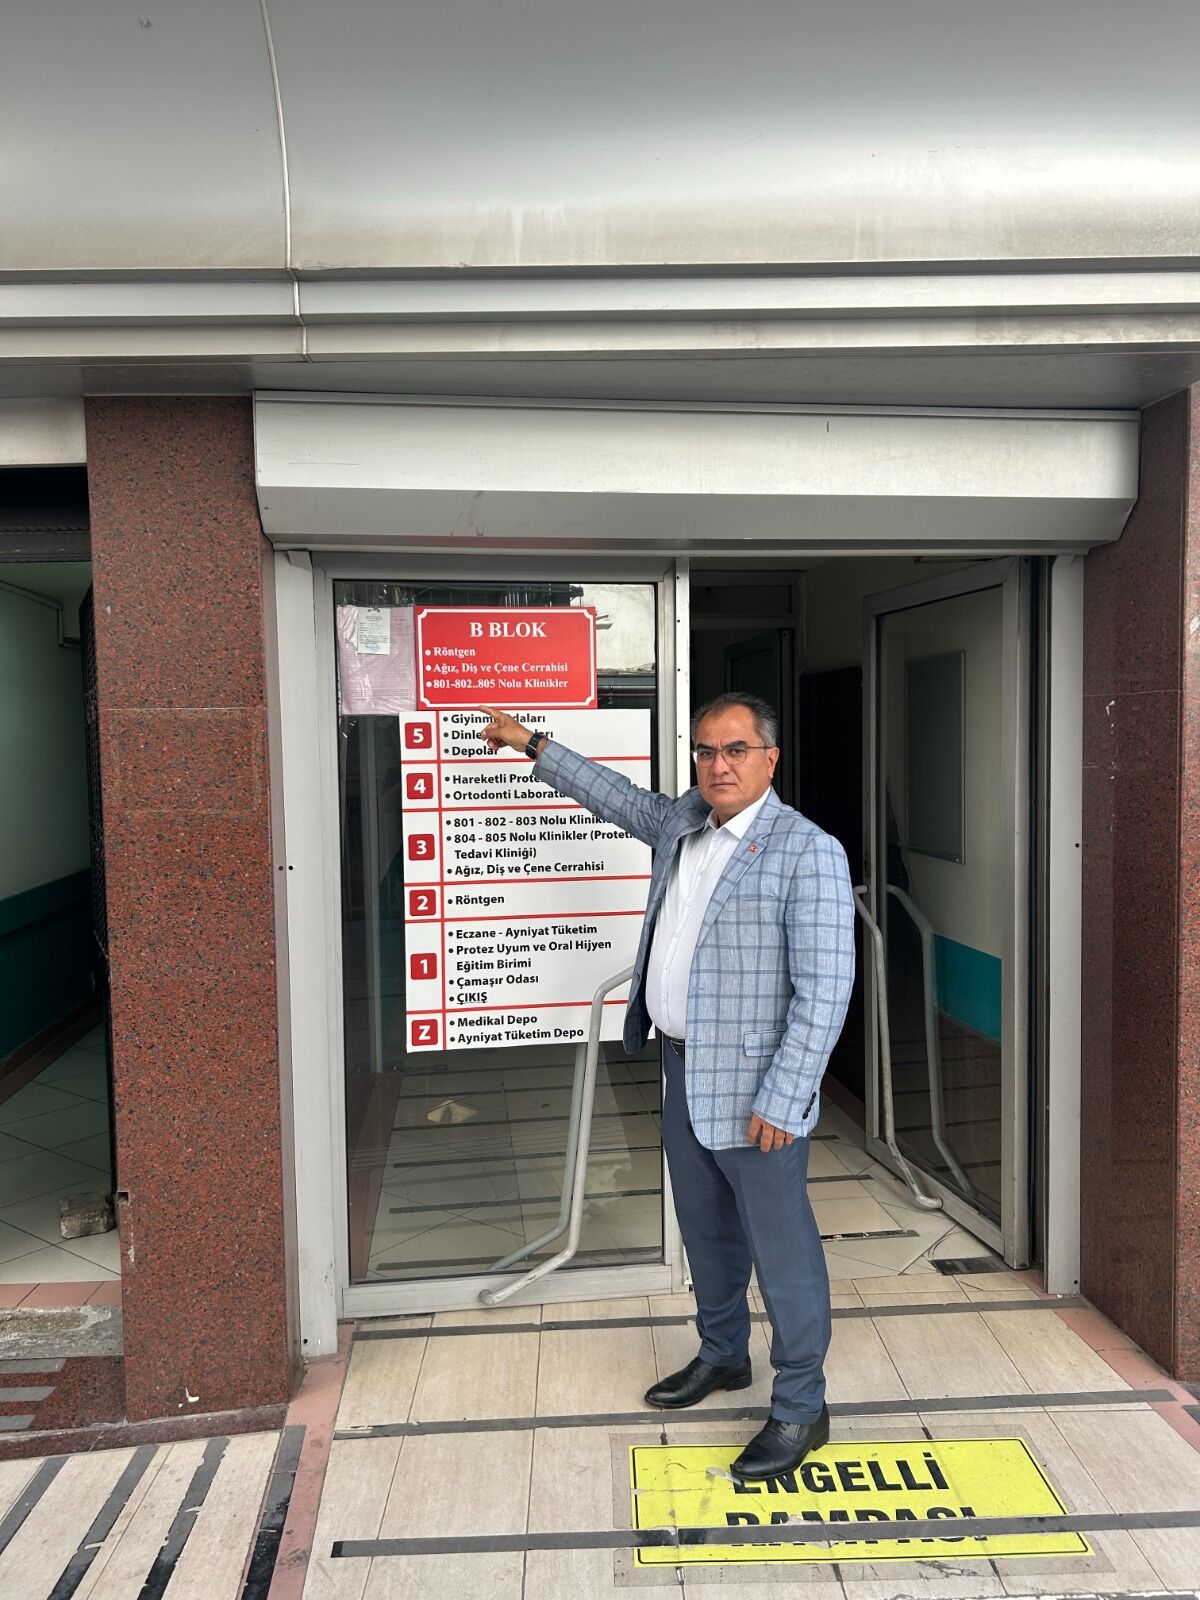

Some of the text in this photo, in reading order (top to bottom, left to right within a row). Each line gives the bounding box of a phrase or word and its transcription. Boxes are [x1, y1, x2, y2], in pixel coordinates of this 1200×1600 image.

[469, 621, 547, 638] B BLOK
[433, 646, 476, 658] Röntgen
[433, 662, 460, 675] Ağız,
[461, 662, 478, 675] Diş
[494, 662, 519, 674] Çene
[521, 662, 568, 673] Cerrahisi
[433, 678, 569, 689] 801-802..805 Nolu Klinikler
[451, 714, 492, 726] Giyinm
[412, 728, 424, 743] 5
[451, 730, 482, 740] Dinle
[413, 779, 426, 793] 4
[453, 774, 507, 785] Hareketli
[453, 789, 511, 801] Ortodonti
[453, 818, 475, 828] 801
[484, 817, 506, 827] 802
[516, 817, 537, 826] 803
[539, 815, 567, 826] Nolu
[454, 834, 475, 844] 804
[485, 833, 507, 843] 805
[509, 831, 537, 842] Nolu
[539, 830, 587, 841] Klinikler
[416, 841, 427, 855] 3
[454, 847, 537, 860] Tedavi Kliniği)
[454, 861, 604, 877] Ağız, Diş ve Çene Cerrahisi
[417, 895, 429, 911] 2
[455, 894, 505, 906] Röntgen
[456, 928, 496, 939] Eczane
[505, 926, 550, 938] Ayniyat
[551, 924, 598, 936] Tüketim
[456, 939, 612, 956] Protez Uyum ve Oral Hijyen
[420, 959, 428, 974] 1
[456, 958, 532, 973] Eğitim Birimi
[456, 974, 539, 990] Çamaşır Odası
[456, 991, 488, 1005] ÇIKIŞ
[457, 1014, 538, 1028] Medikal Depo
[418, 1025, 431, 1040] Z
[457, 1027, 585, 1045] Ayniyat Tüketim Depo
